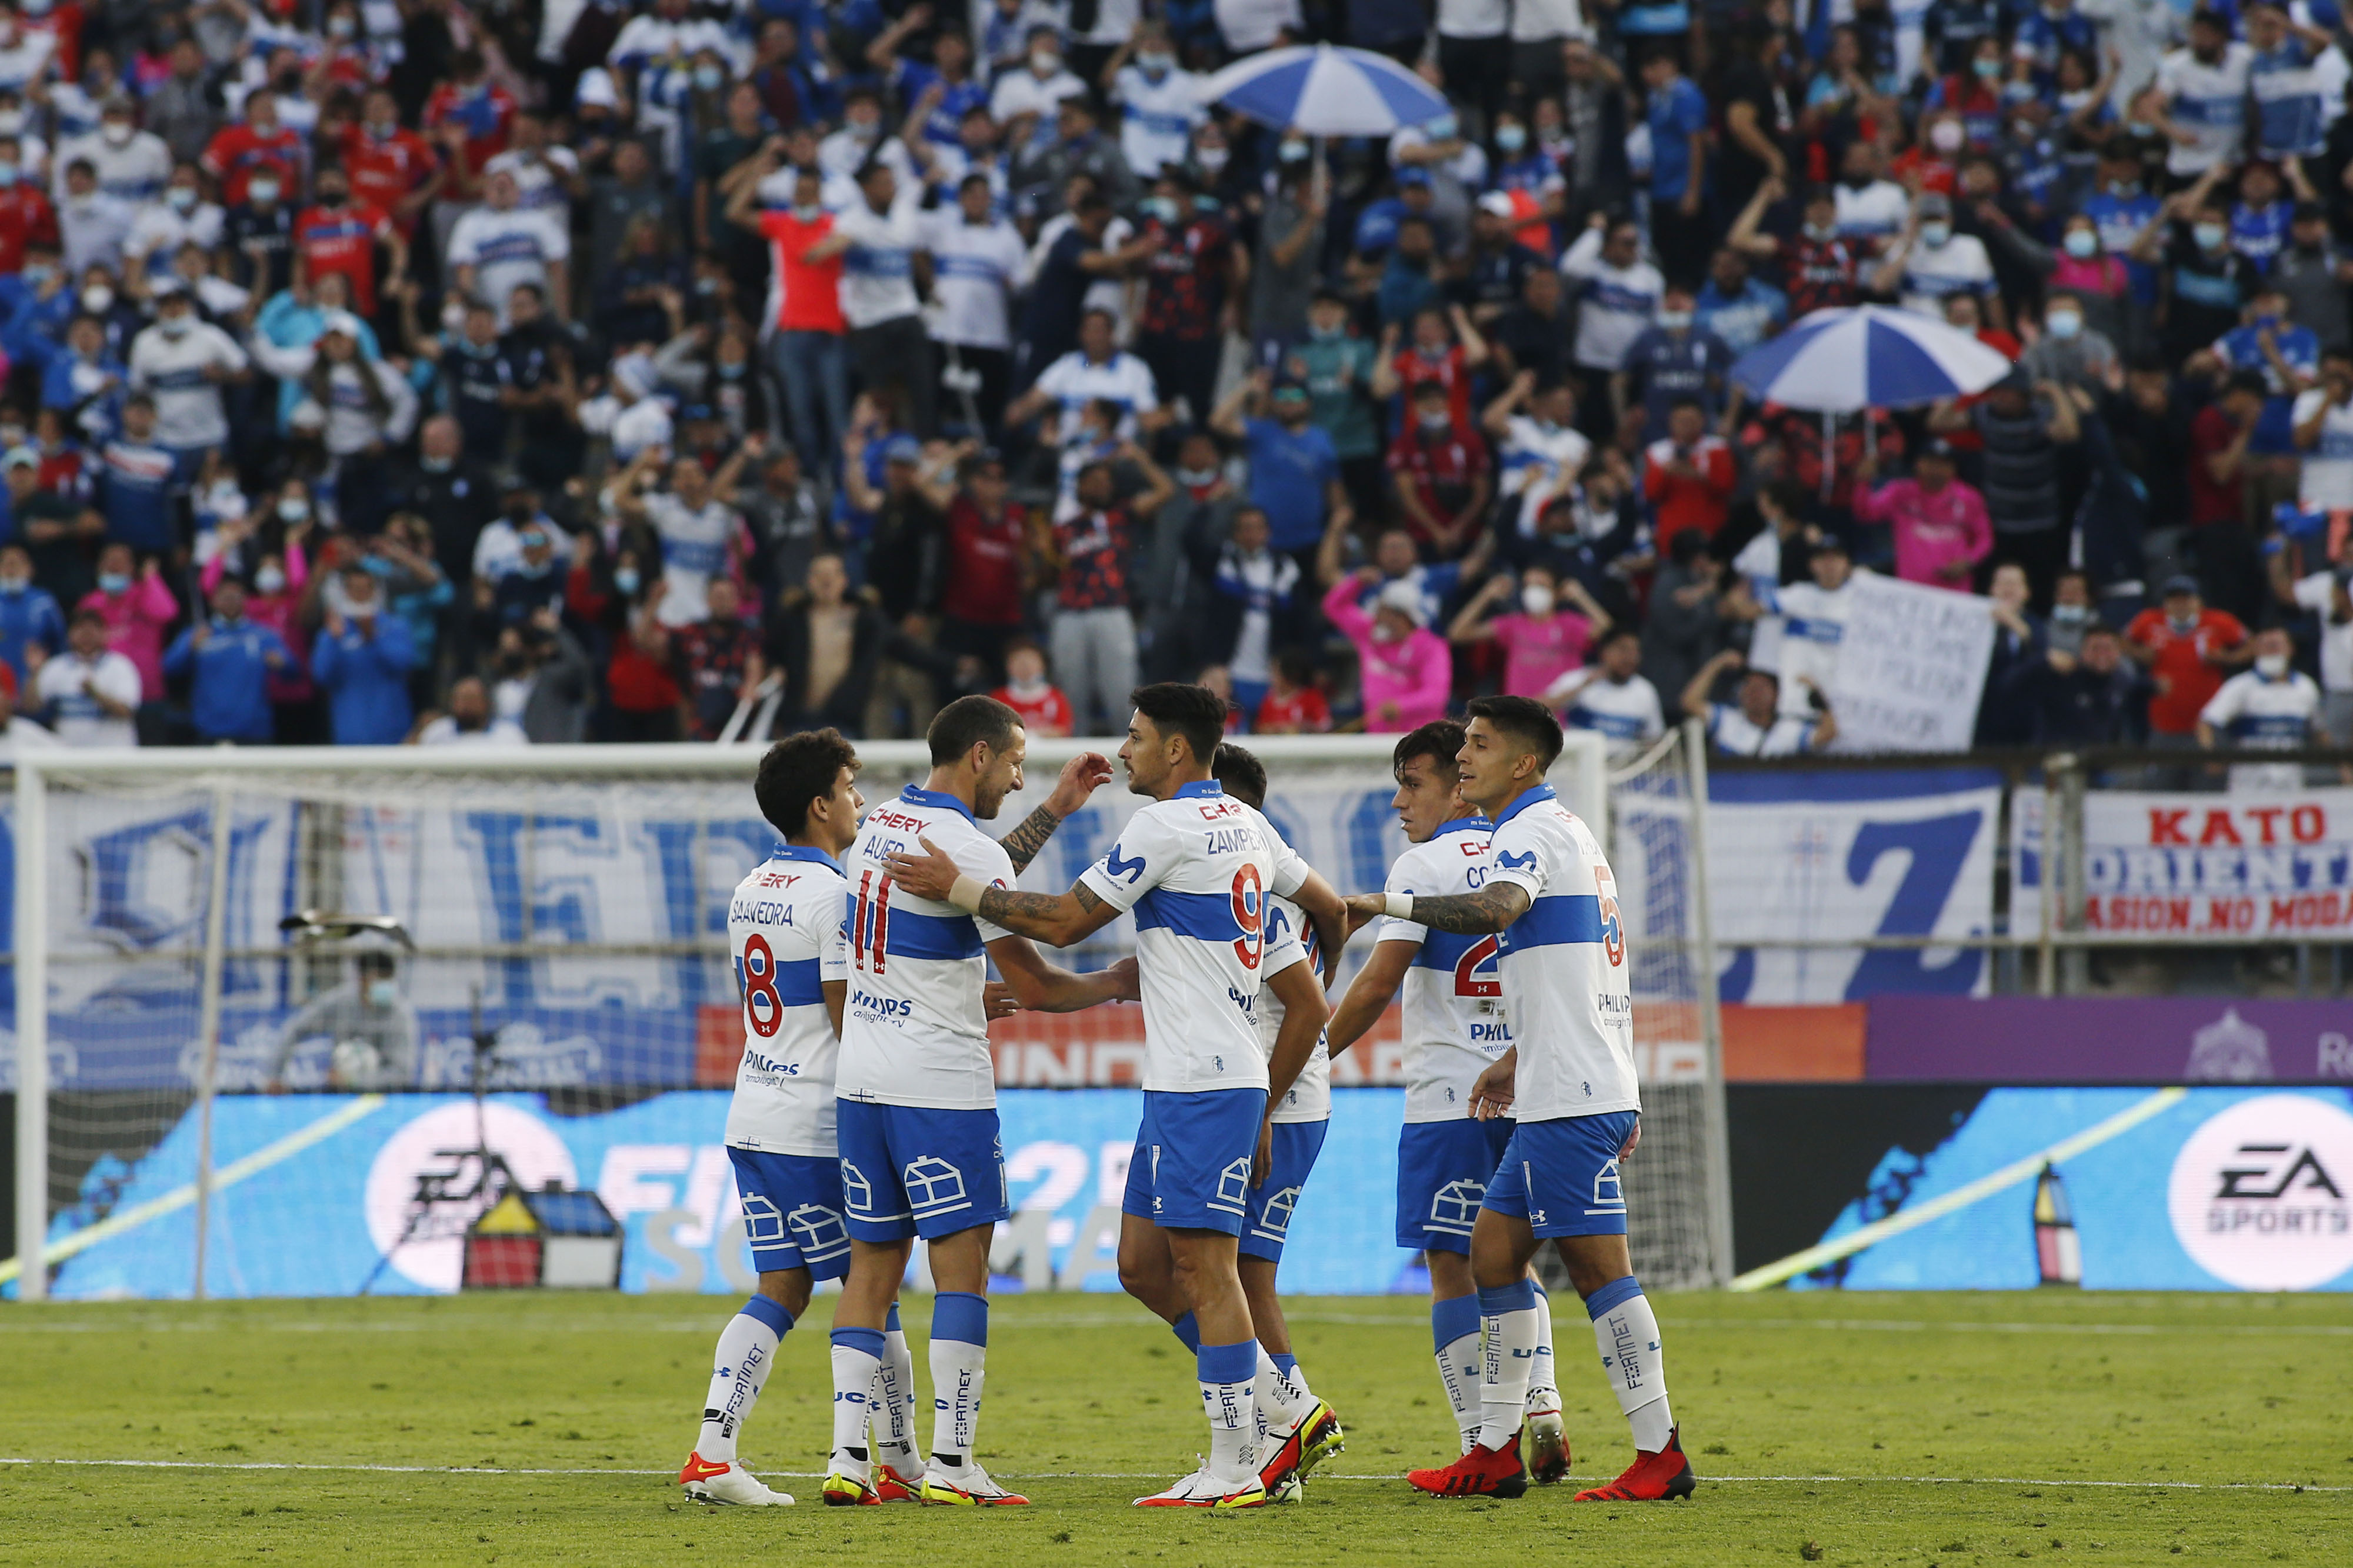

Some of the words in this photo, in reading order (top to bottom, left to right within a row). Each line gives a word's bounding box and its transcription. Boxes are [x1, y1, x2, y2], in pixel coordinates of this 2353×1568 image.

[868, 809, 932, 835] CHERY
[2148, 803, 2327, 846] KATO
[2087, 849, 2352, 889] ORIENT
[731, 901, 794, 927] SAAVEDRA
[854, 869, 892, 975] 11
[1232, 862, 1263, 970] 9
[1593, 865, 1625, 968] 5
[744, 934, 783, 1037] 8
[1598, 993, 1630, 1013] PHILIP
[1471, 1023, 1514, 1041] PHIL
[2216, 1146, 2344, 1199] EA
[2207, 1207, 2349, 1234] SPORTS
[1438, 1348, 1466, 1412] FORTINE
[955, 1369, 971, 1447] FORTINET
